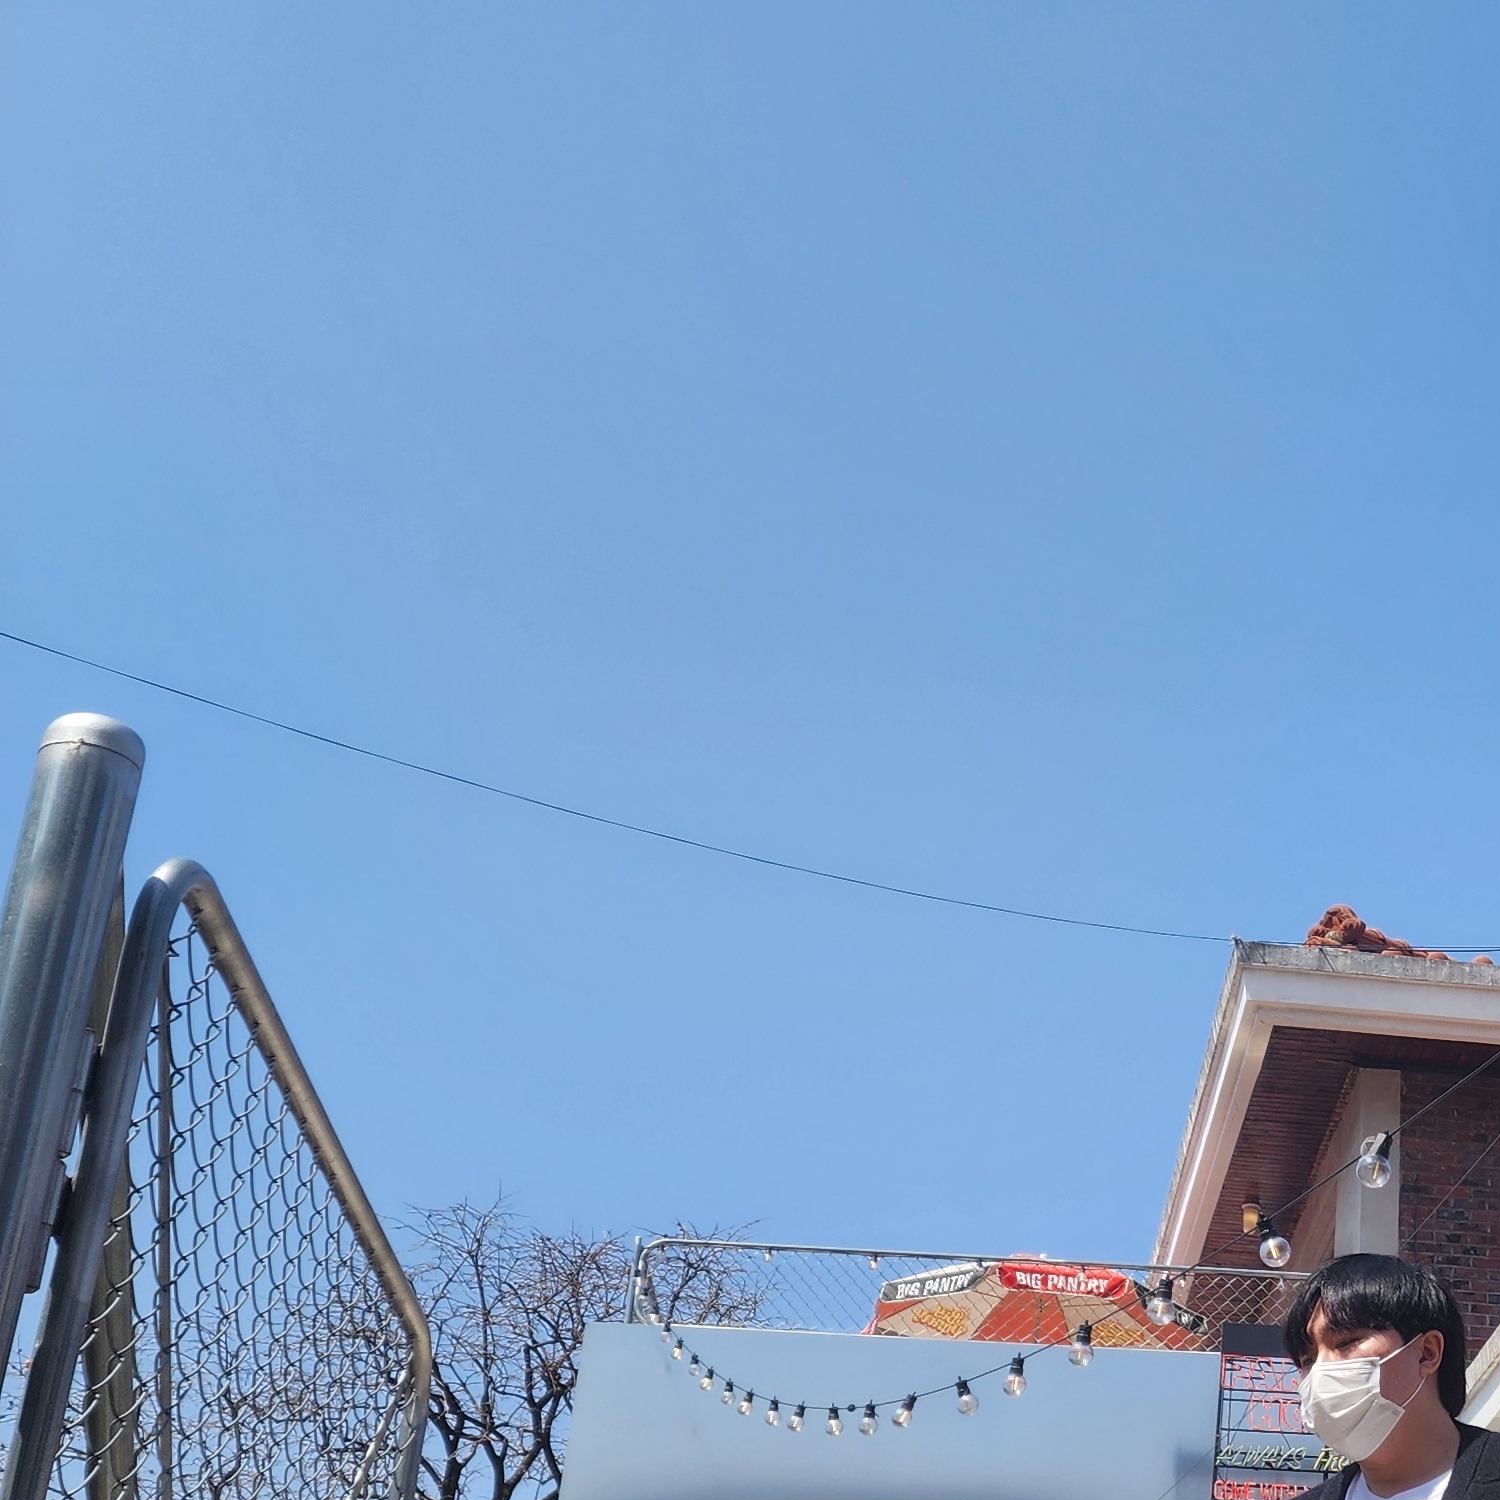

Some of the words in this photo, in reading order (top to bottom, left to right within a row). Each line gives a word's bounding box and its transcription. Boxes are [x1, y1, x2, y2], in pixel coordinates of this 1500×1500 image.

[896, 1283, 920, 1299] BIG
[922, 1271, 974, 1296] PANTRY
[1016, 1271, 1041, 1289] BIG
[1215, 1444, 1306, 1470] ALWAYS
